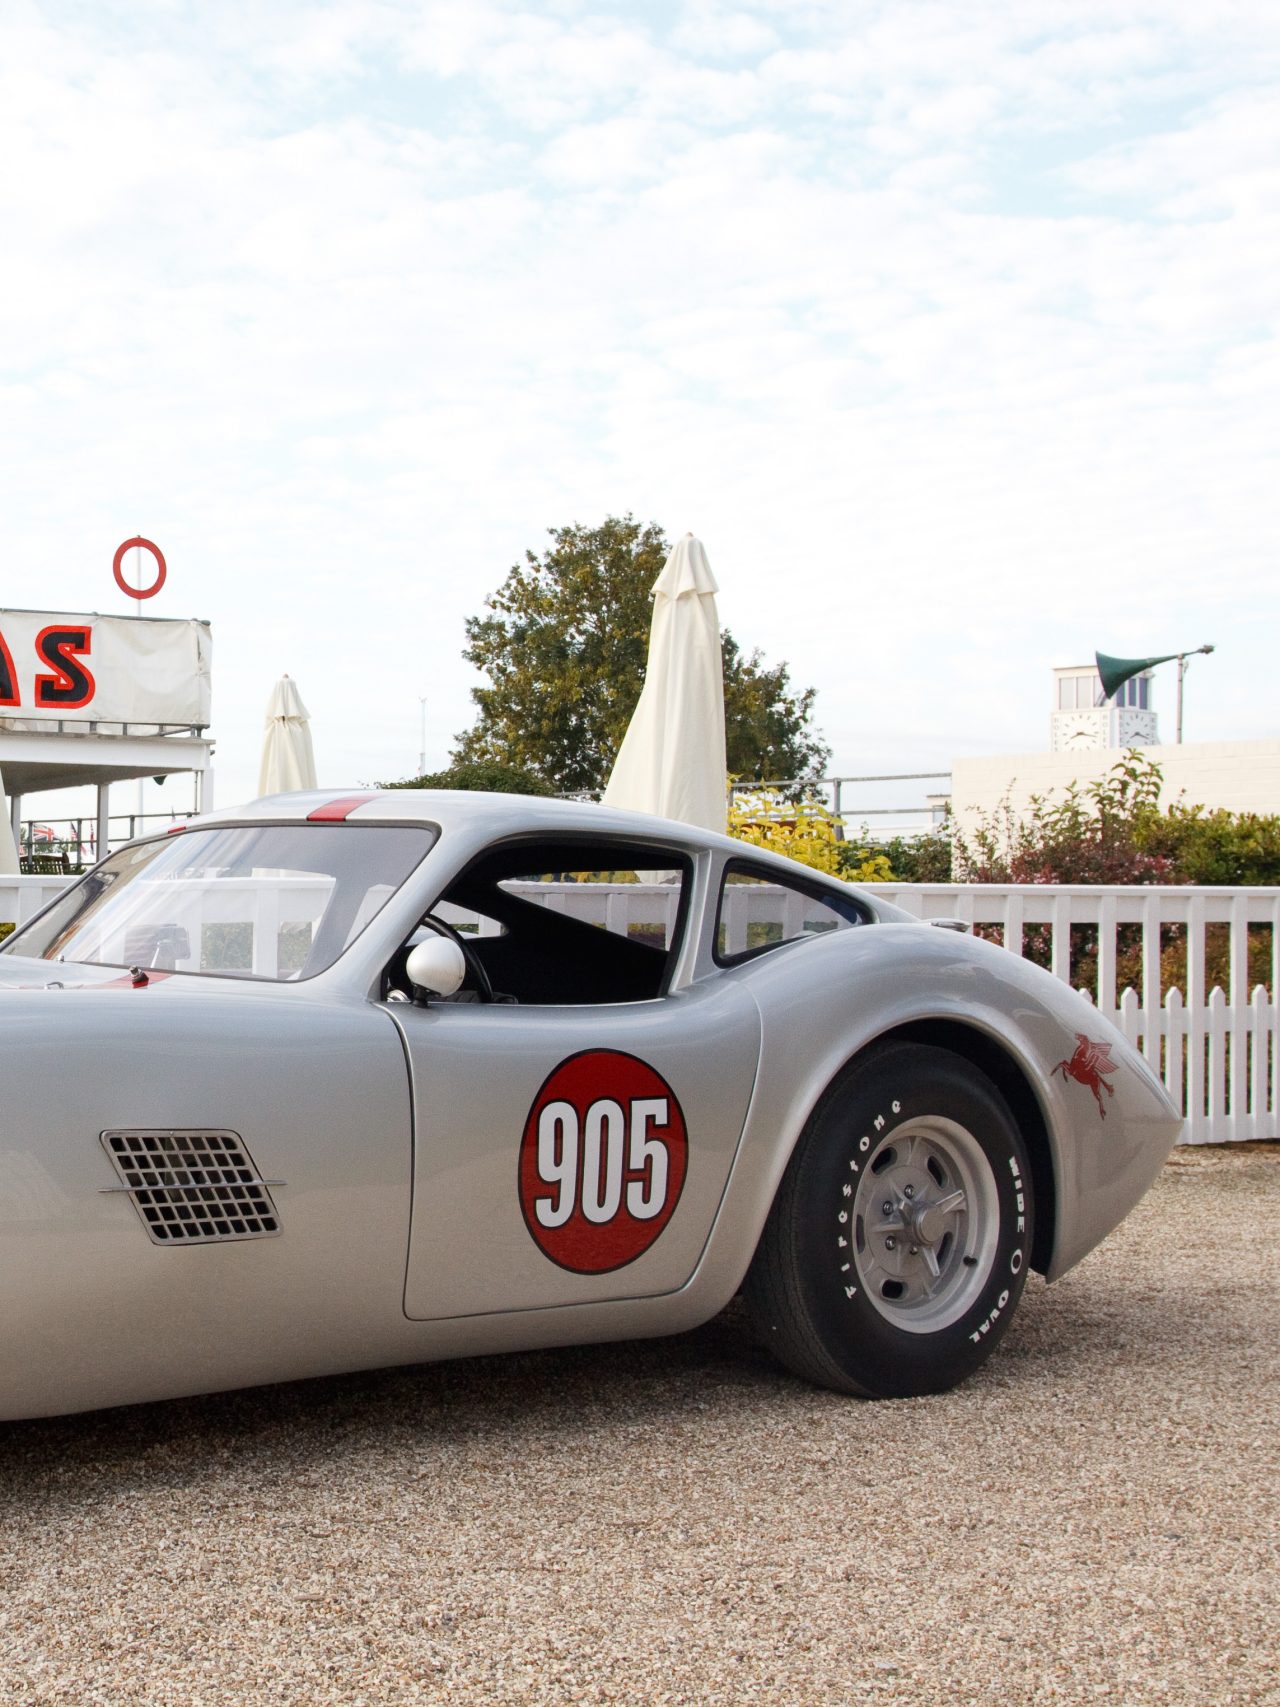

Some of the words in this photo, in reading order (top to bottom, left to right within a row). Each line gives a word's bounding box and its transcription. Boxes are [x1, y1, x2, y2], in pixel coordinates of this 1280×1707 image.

[534, 1097, 669, 1229] 905
[1008, 1155, 1026, 1234] WIDE
[968, 1289, 1010, 1344] OVAL
